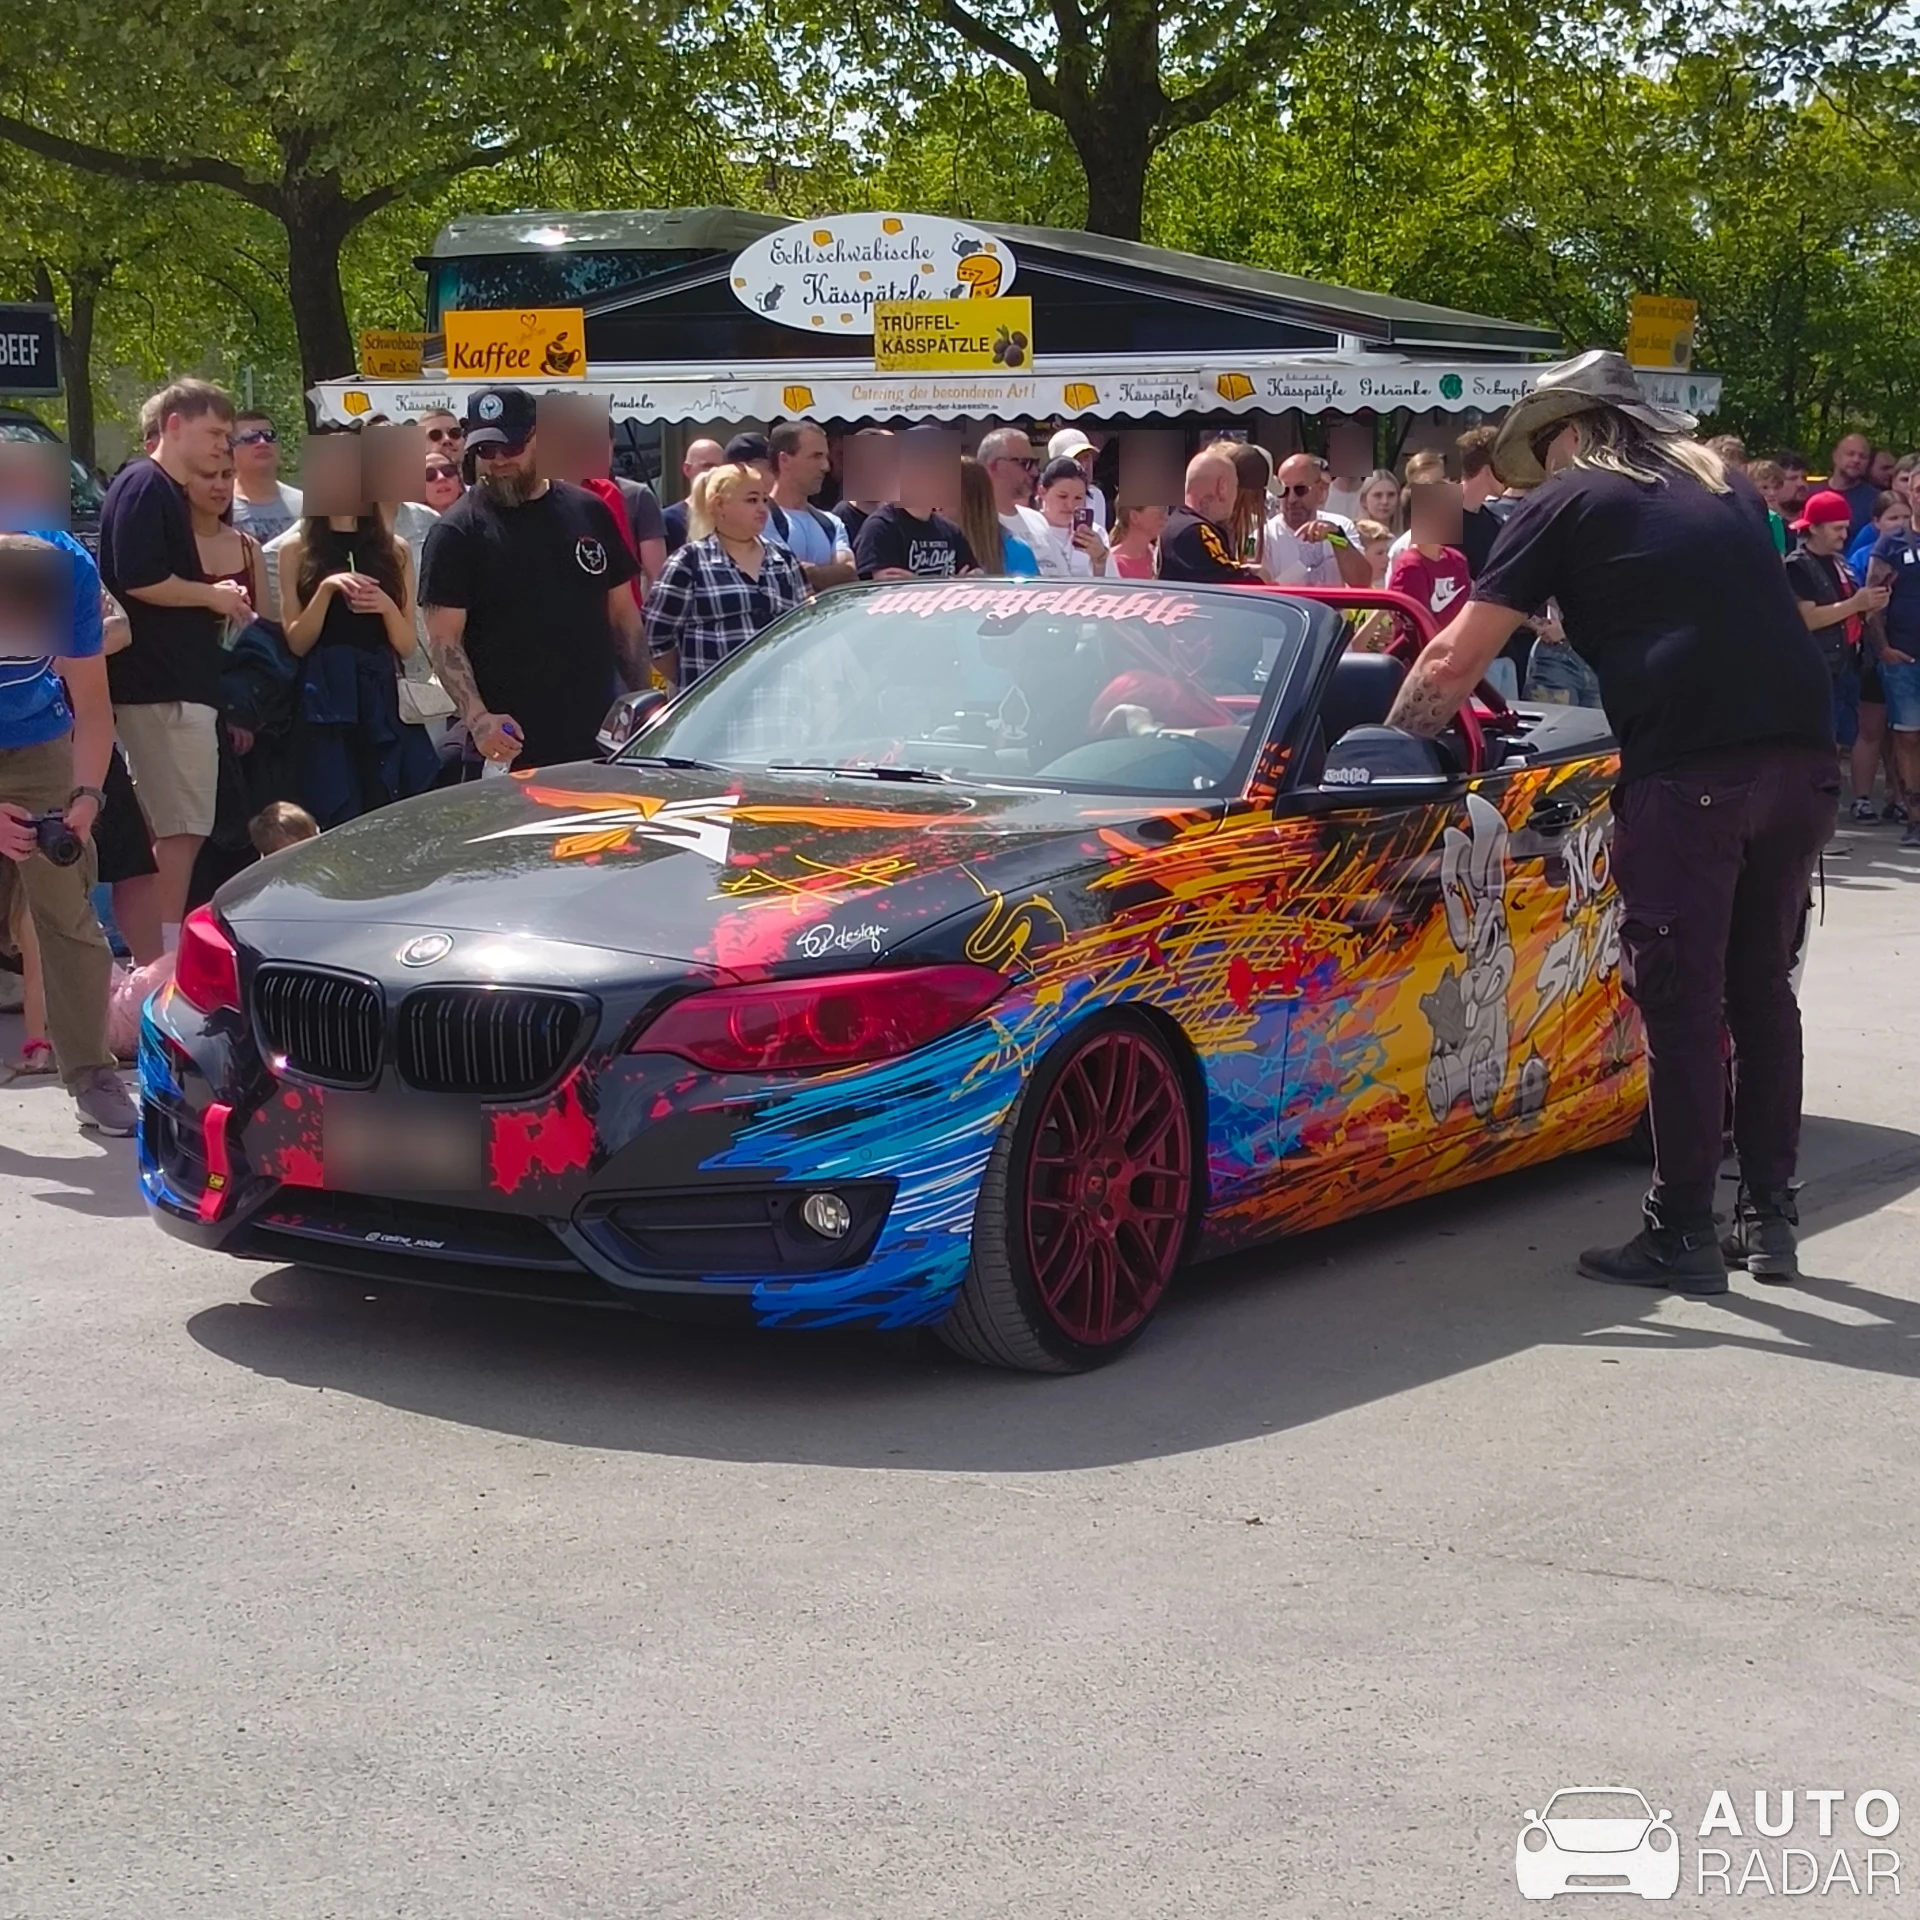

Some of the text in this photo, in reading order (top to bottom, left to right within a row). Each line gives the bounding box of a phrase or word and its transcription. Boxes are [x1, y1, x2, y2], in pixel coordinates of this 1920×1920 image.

[770, 236, 934, 265] Echt schwäbische
[803, 273, 932, 314] Kässpätzle
[882, 313, 960, 331] TRÜFFEL-
[0, 334, 40, 366] BEEF
[453, 341, 531, 374] Kaffee
[882, 336, 990, 354] KÄSSPÄTZLE
[852, 384, 904, 401] Catering
[908, 384, 928, 399] der
[933, 384, 1003, 399] besonderen
[1118, 383, 1198, 407] Kässpätzle
[1267, 378, 1431, 403] Kässpätzle Getränke
[1562, 824, 1609, 920] NO
